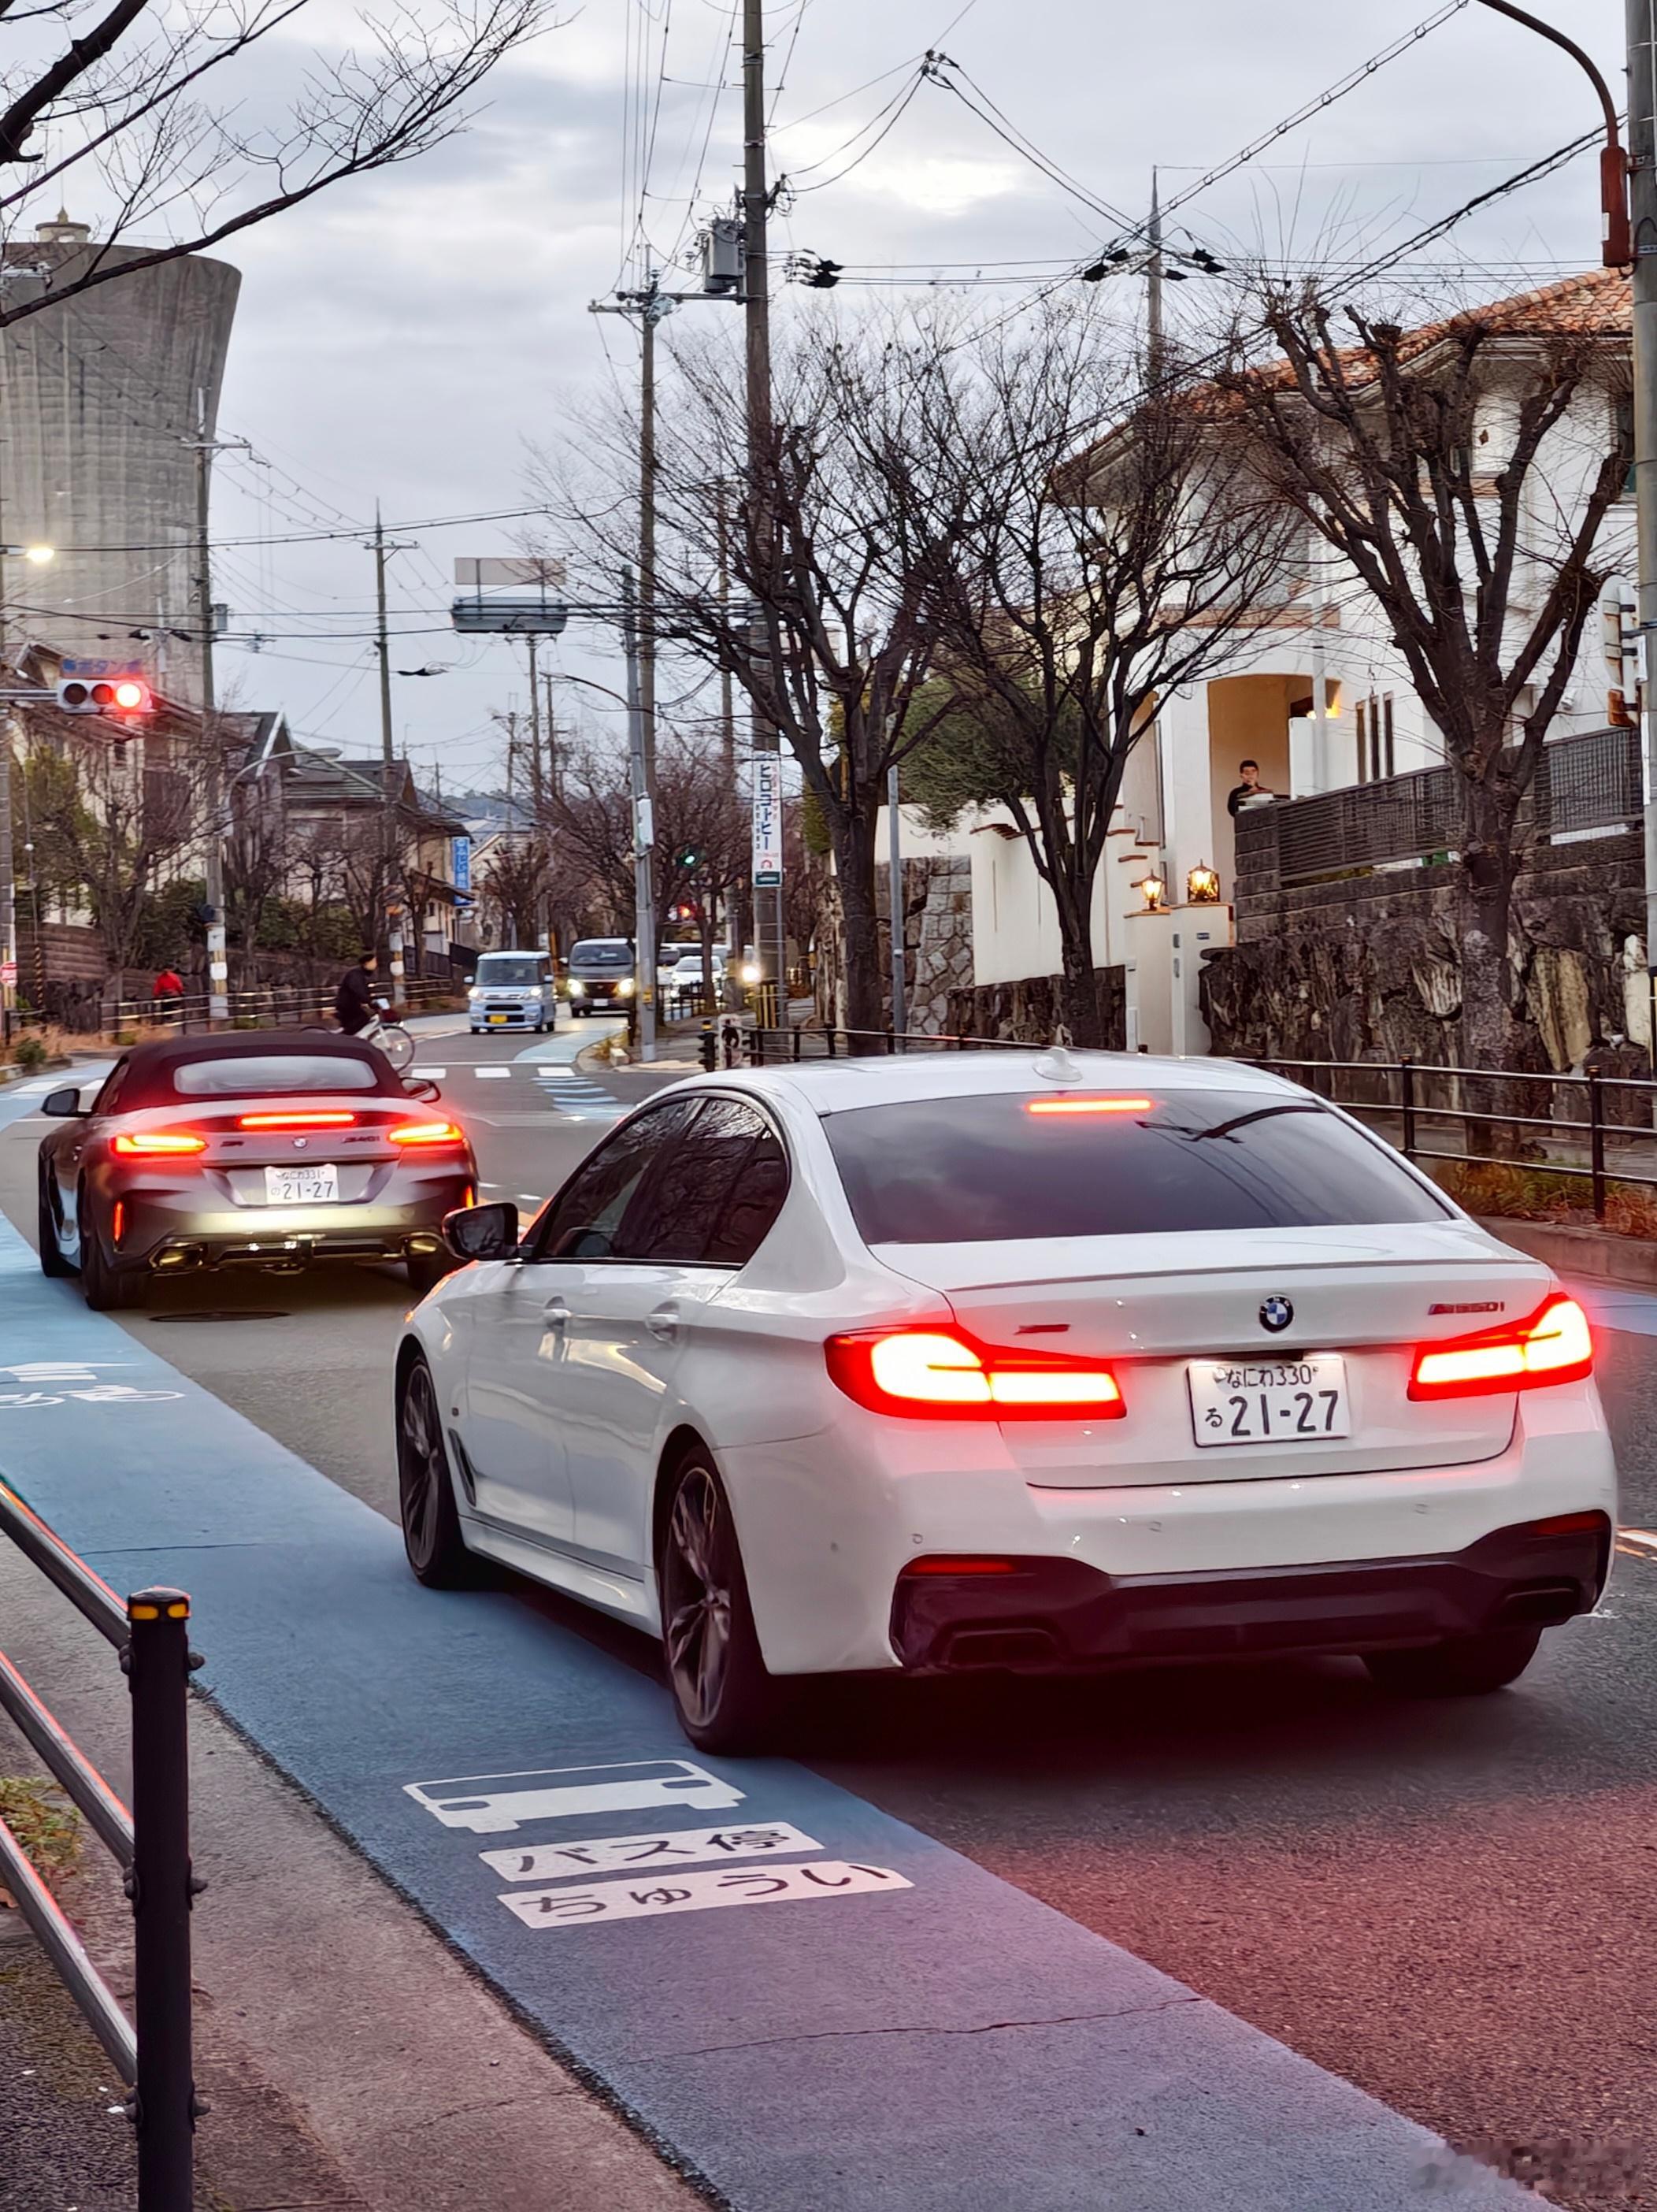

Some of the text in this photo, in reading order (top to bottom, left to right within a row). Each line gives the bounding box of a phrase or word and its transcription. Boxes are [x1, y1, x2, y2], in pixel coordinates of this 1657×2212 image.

[283, 1181, 334, 1200] 21-27
[1204, 1390, 1339, 1437] る 21-27
[518, 1829, 792, 1873] バス停
[520, 1863, 892, 1918] ちゅうい
